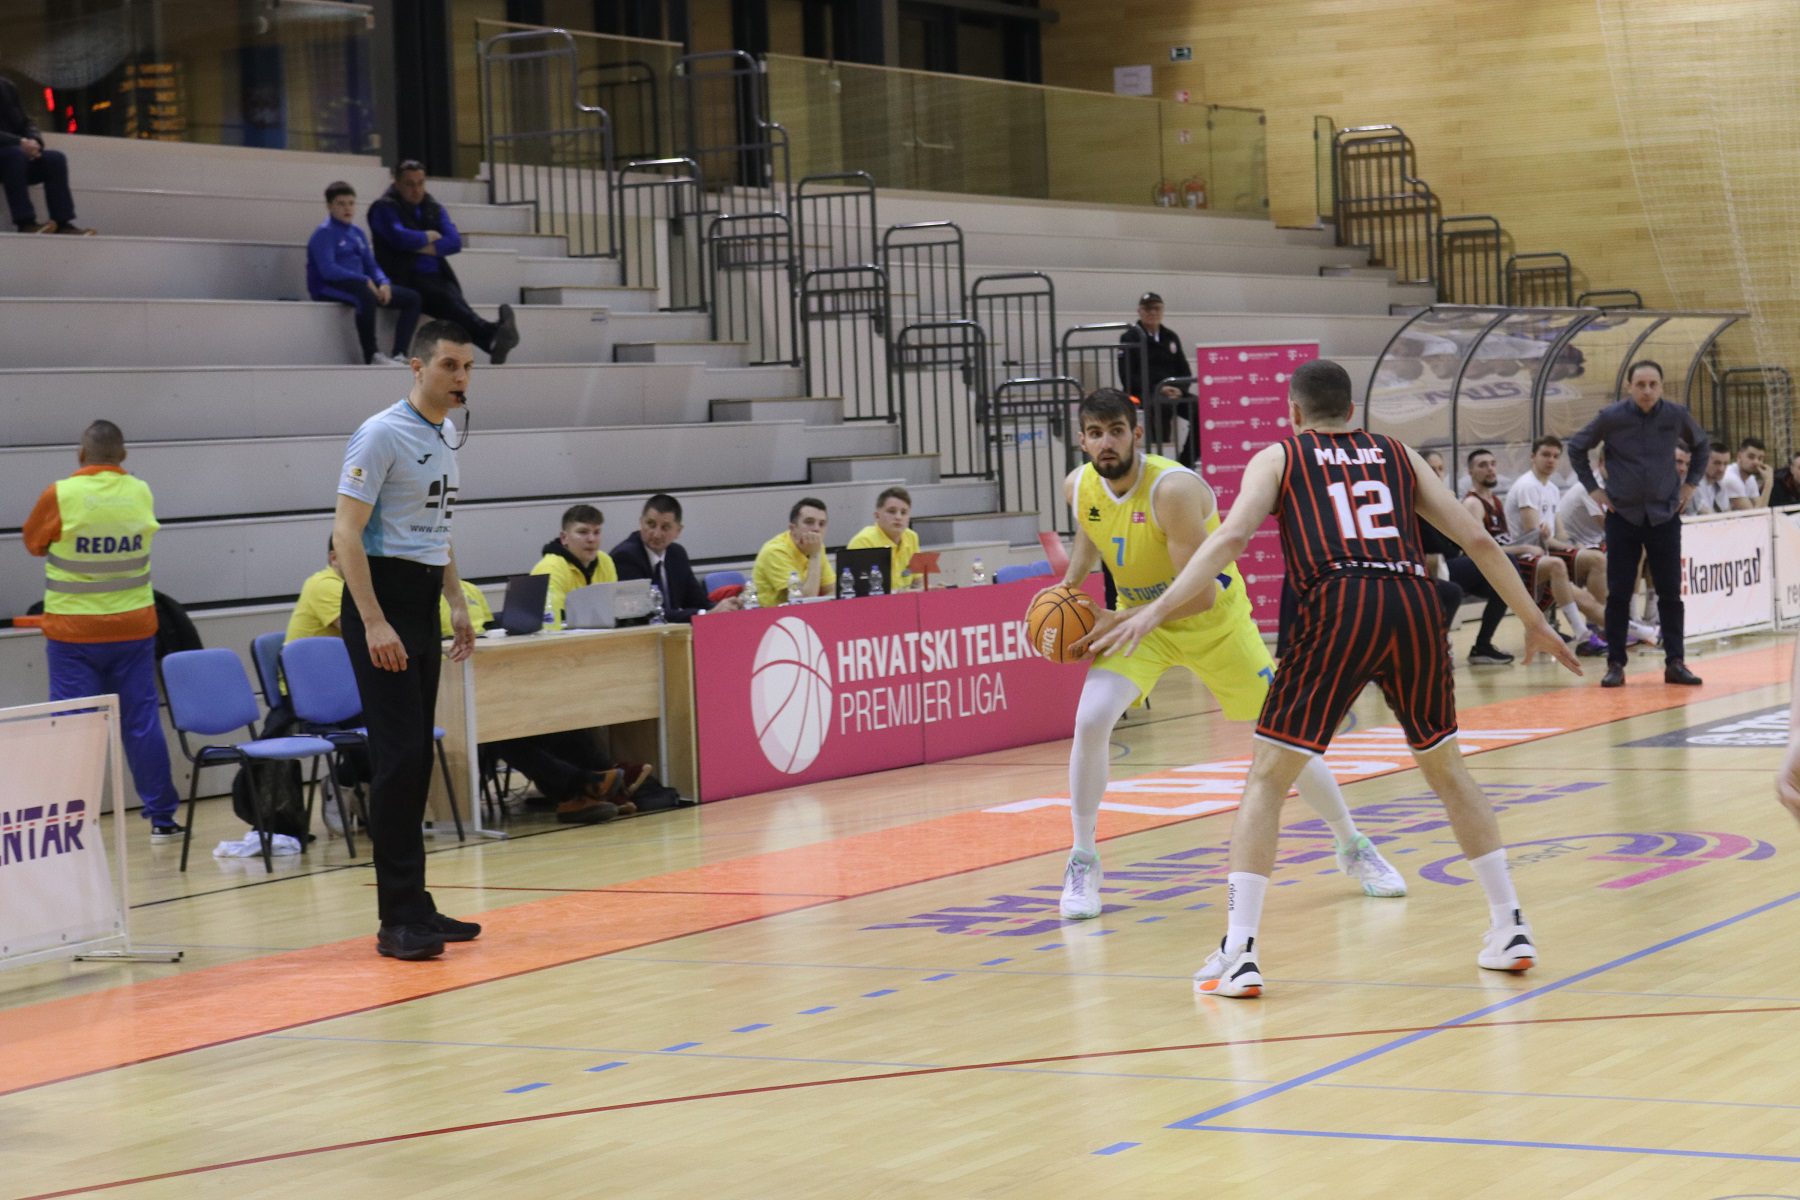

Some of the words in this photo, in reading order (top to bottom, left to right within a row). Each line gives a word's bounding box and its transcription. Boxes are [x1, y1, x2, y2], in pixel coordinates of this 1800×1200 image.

[1327, 480, 1400, 539] 12
[76, 534, 143, 554] REDAR
[1112, 537, 1125, 566] 7
[1689, 546, 1761, 597] kamgrad
[1786, 583, 1800, 607] re
[837, 628, 958, 683] HRVATSKI
[961, 619, 1042, 667] TELEK
[839, 679, 952, 736] PREMIJER
[958, 671, 1008, 718] LIGA
[0, 799, 86, 867] NTAR
